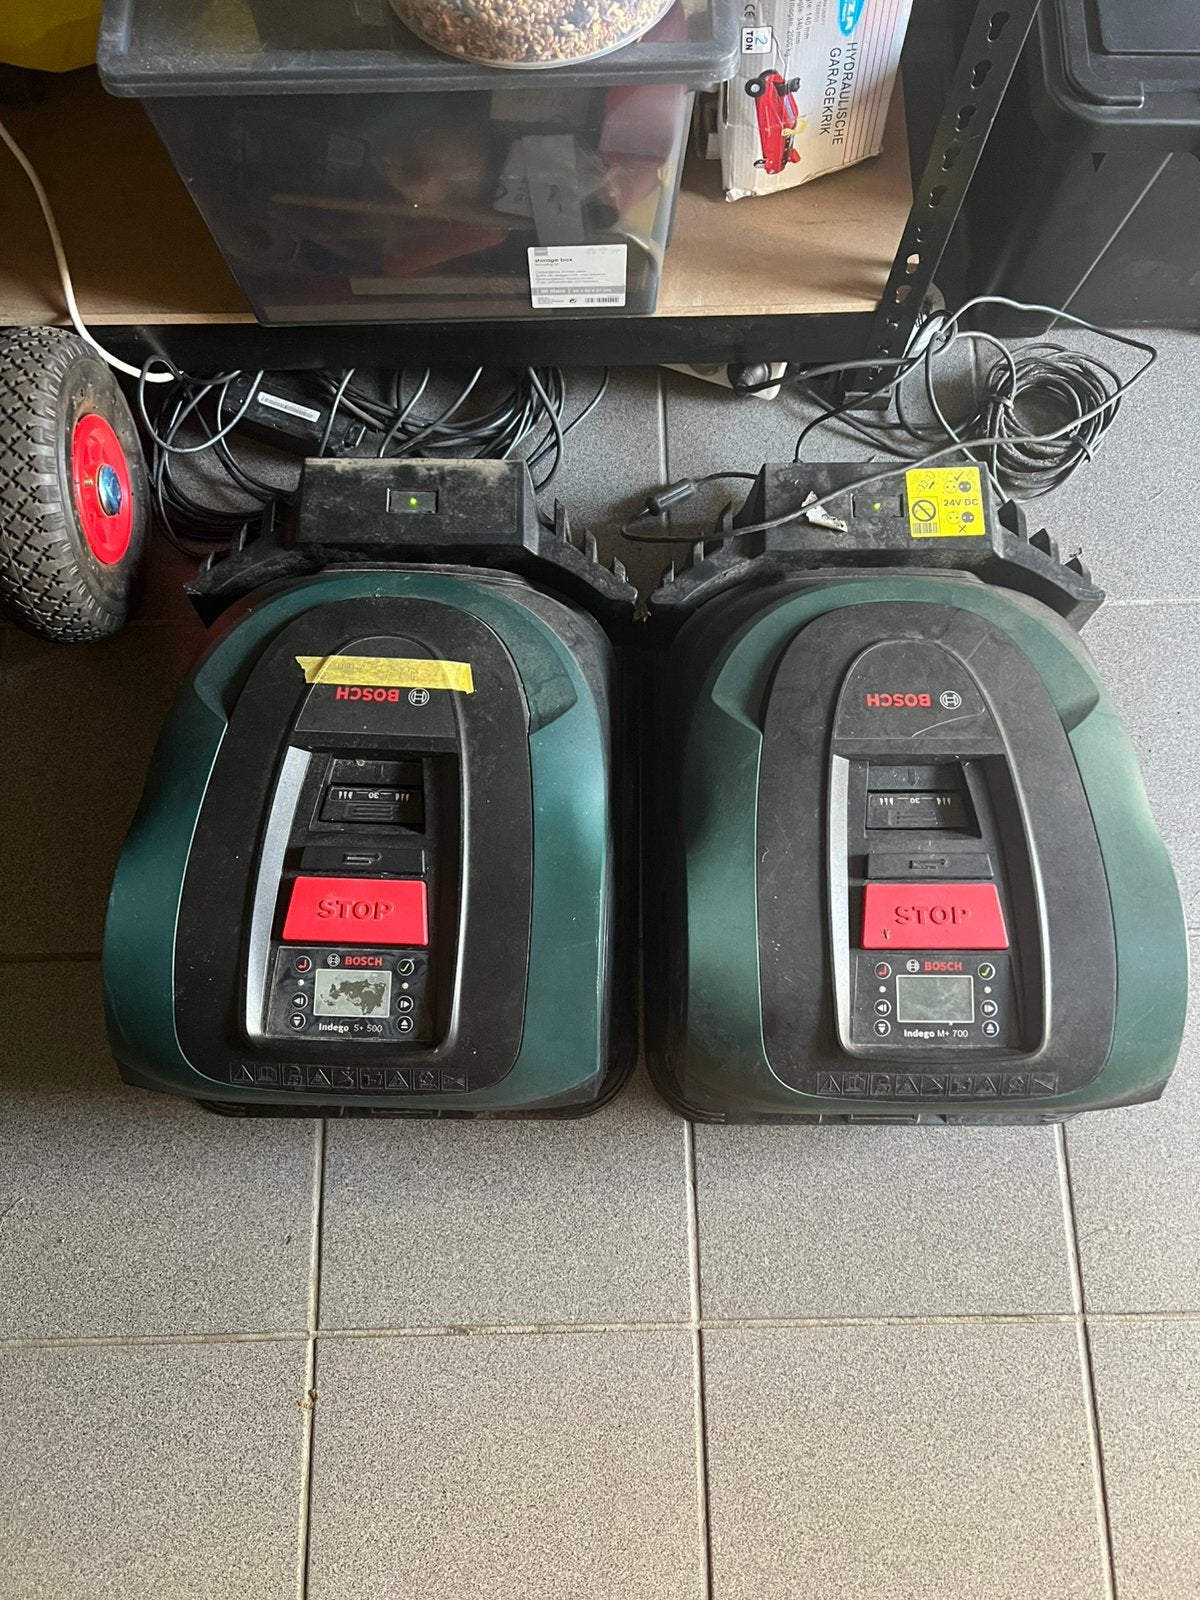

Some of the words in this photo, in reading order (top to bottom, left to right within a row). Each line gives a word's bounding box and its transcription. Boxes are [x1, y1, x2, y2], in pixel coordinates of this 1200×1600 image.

[745, 30, 754, 51] TON
[755, 36, 769, 45] 2
[819, 47, 842, 136] GARAGEKRIK
[832, 42, 858, 145] HYDRAULISCHE
[943, 499, 961, 507] 24V
[964, 498, 979, 506] DC
[336, 686, 400, 703] BOSCH
[866, 692, 932, 708] BOSCH
[368, 791, 380, 799] 30
[317, 898, 395, 920] STOP
[894, 905, 972, 926] STOP
[344, 955, 383, 967] BOSCH
[924, 961, 963, 972] BOSCH
[318, 1022, 350, 1034] Indego
[353, 1023, 364, 1032] S+
[366, 1024, 383, 1033] 500
[903, 1029, 935, 1039] Indego
[936, 1029, 950, 1038] M+
[952, 1029, 969, 1038] 700
